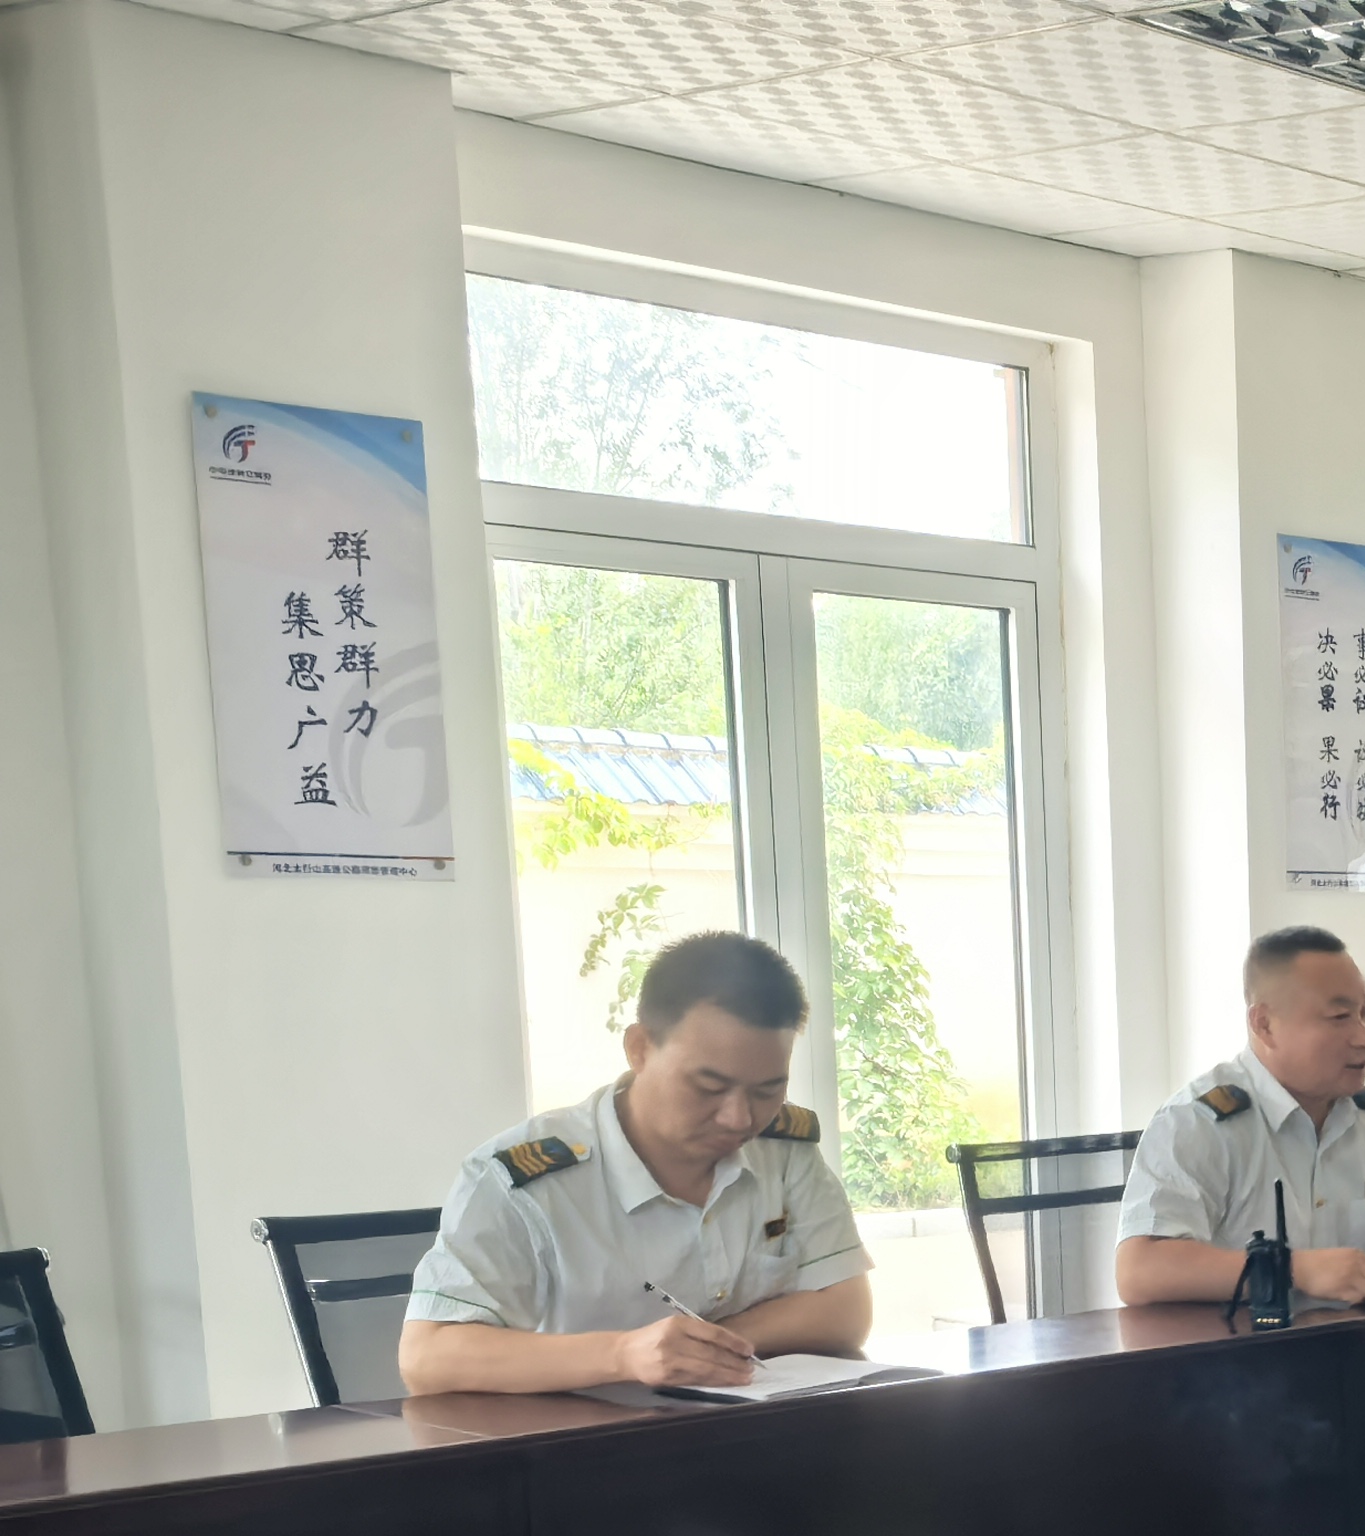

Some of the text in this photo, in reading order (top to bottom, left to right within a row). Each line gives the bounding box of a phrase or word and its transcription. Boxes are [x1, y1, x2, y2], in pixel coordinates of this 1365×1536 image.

[281, 591, 337, 807] 集思广益
[326, 529, 379, 738] 群策群力
[1319, 735, 1341, 821] 果必行
